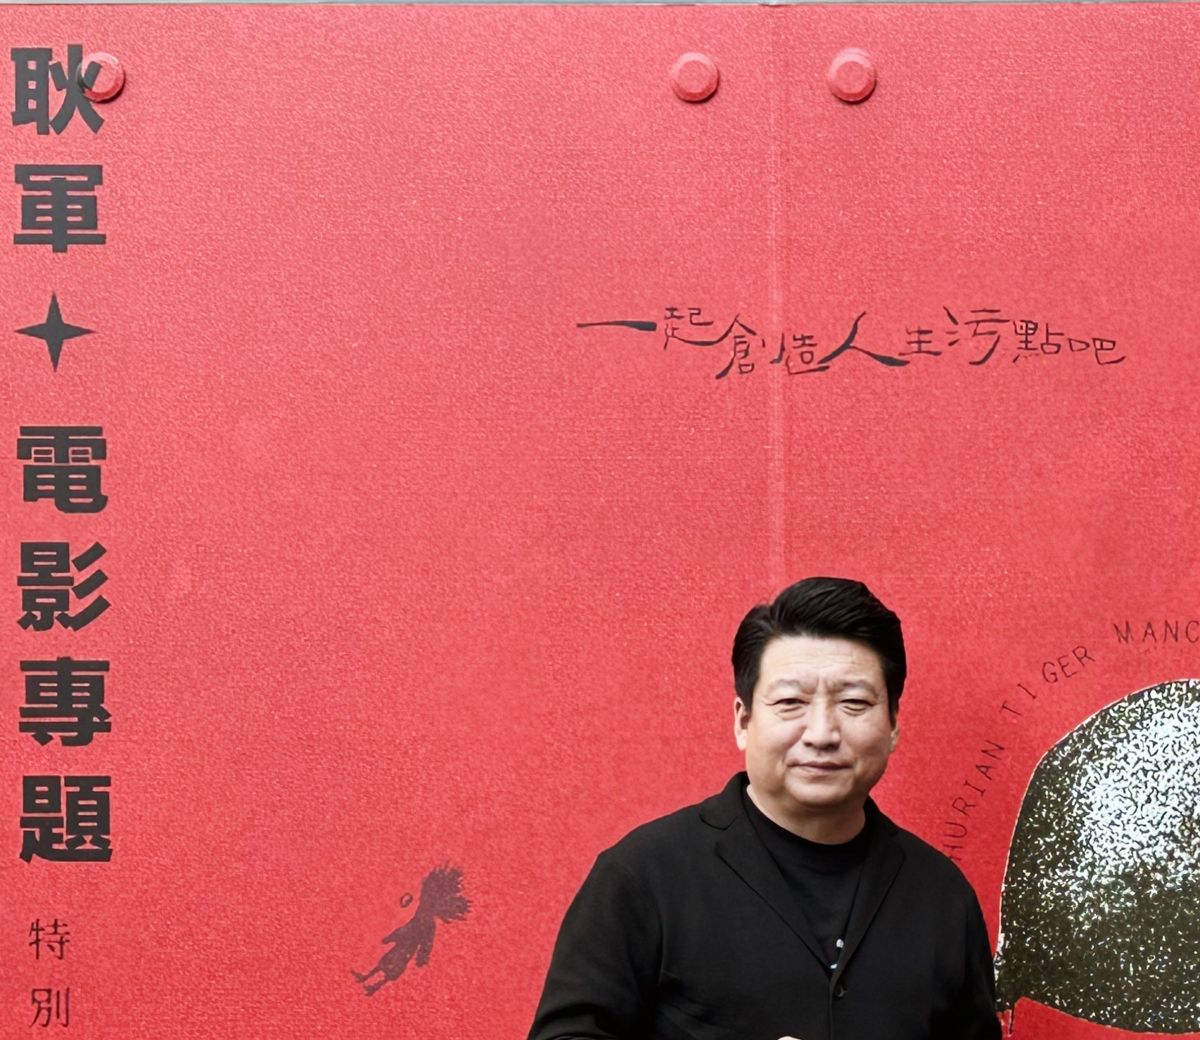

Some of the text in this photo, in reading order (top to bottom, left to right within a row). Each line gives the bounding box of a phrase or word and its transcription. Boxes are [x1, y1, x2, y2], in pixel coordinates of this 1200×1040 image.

[11, 44, 113, 863] 耿軍 電影專題
[1000, 645, 1096, 716] TIGER
